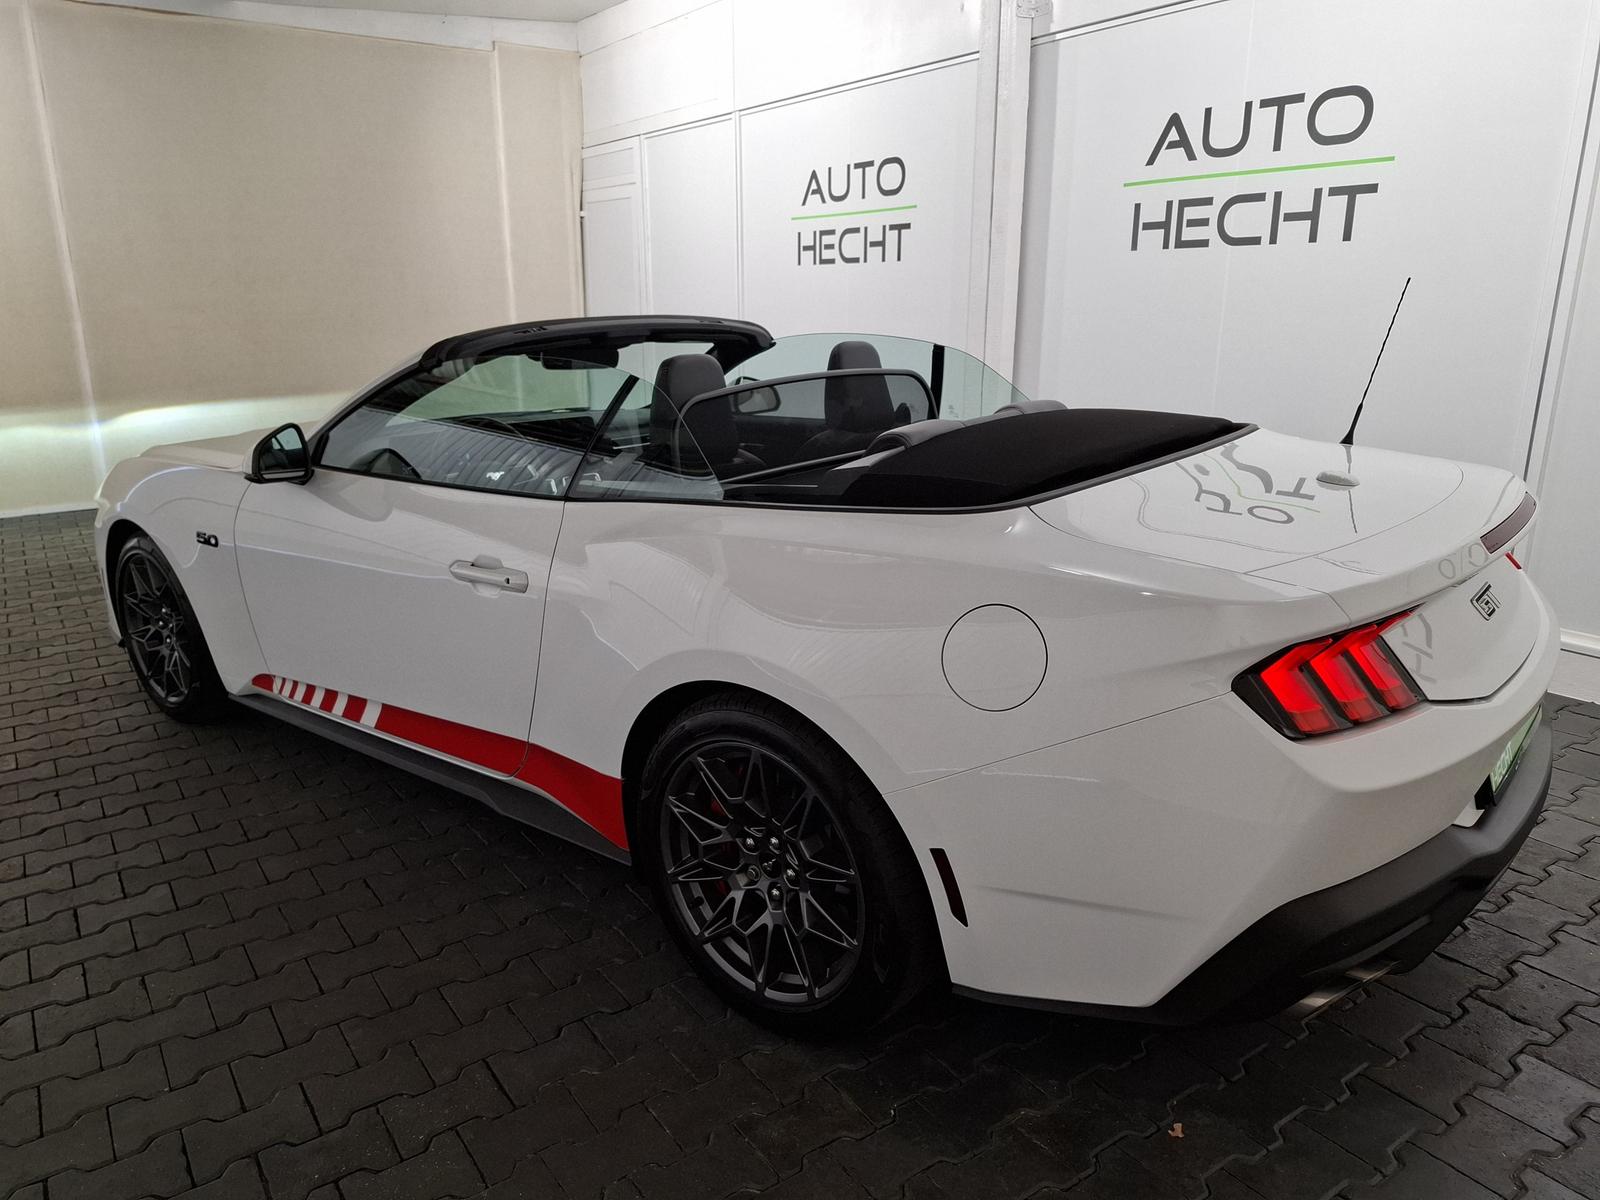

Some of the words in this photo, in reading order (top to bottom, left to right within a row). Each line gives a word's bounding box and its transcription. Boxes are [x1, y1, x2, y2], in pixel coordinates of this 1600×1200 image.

[1144, 85, 1374, 167] AUTO
[801, 156, 906, 207] AUTO
[1130, 182, 1379, 252] HECHT
[797, 222, 911, 266] HECHT
[1470, 581, 1502, 621] GT
